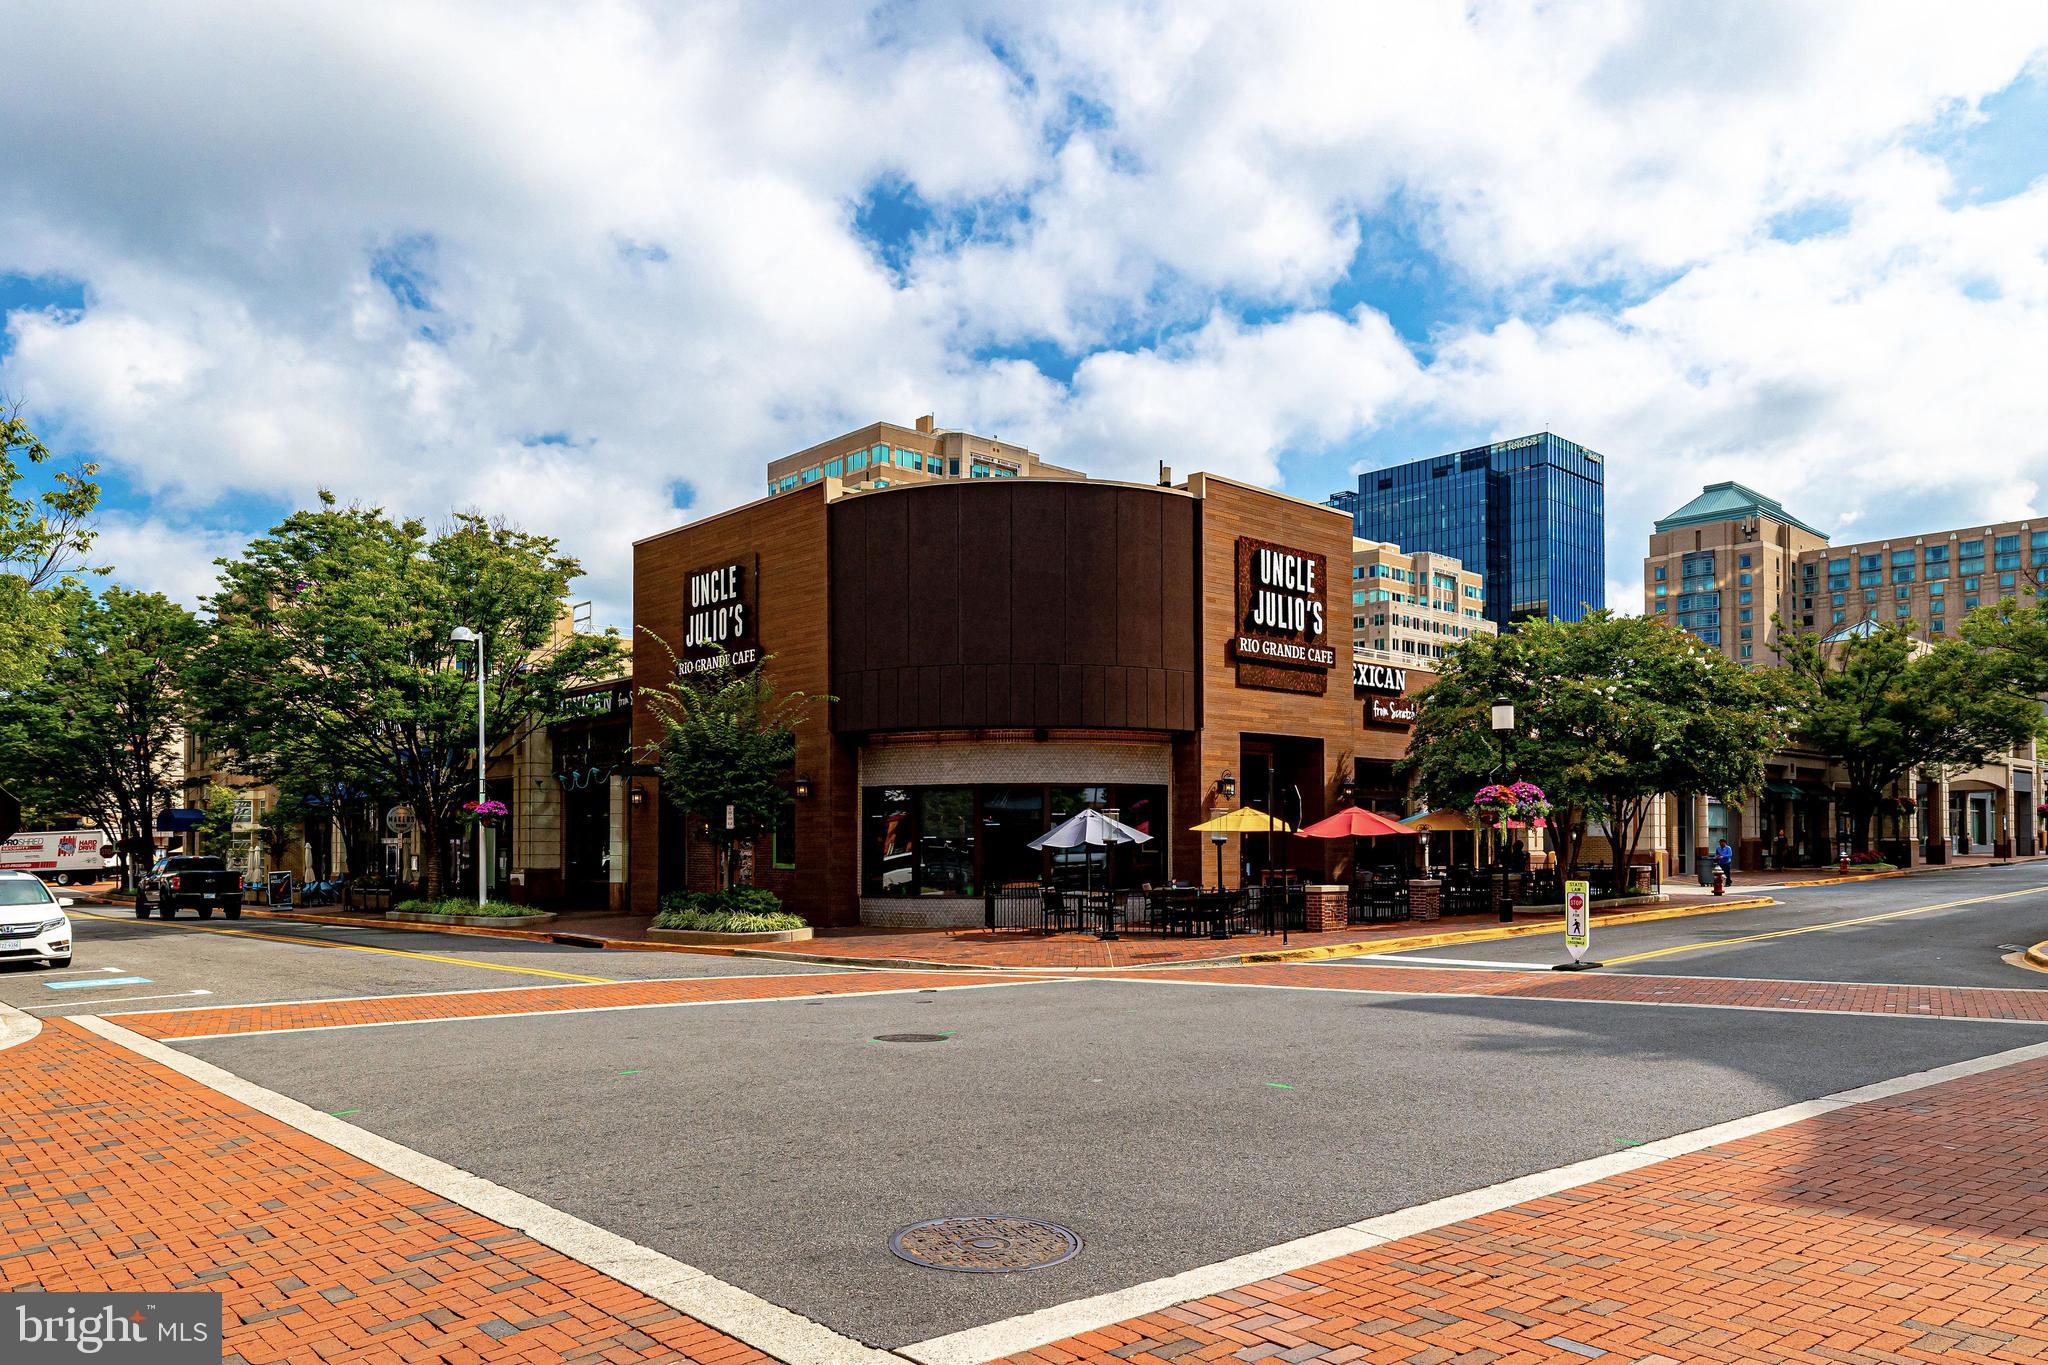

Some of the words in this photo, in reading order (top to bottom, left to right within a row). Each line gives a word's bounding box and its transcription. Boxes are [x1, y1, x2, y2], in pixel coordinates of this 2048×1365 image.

[691, 565, 737, 608] UNCLE
[1260, 548, 1316, 594] UNCLE
[685, 603, 743, 647] JULIO'S
[1253, 589, 1323, 635] JULIO'S
[679, 661, 694, 675] RIO
[695, 654, 731, 672] GRANDE
[732, 649, 756, 665] CAFE
[1239, 637, 1260, 653] RIO
[1262, 640, 1306, 660] GRANDE
[1307, 647, 1334, 665] CAFE
[1373, 700, 1389, 717] from
